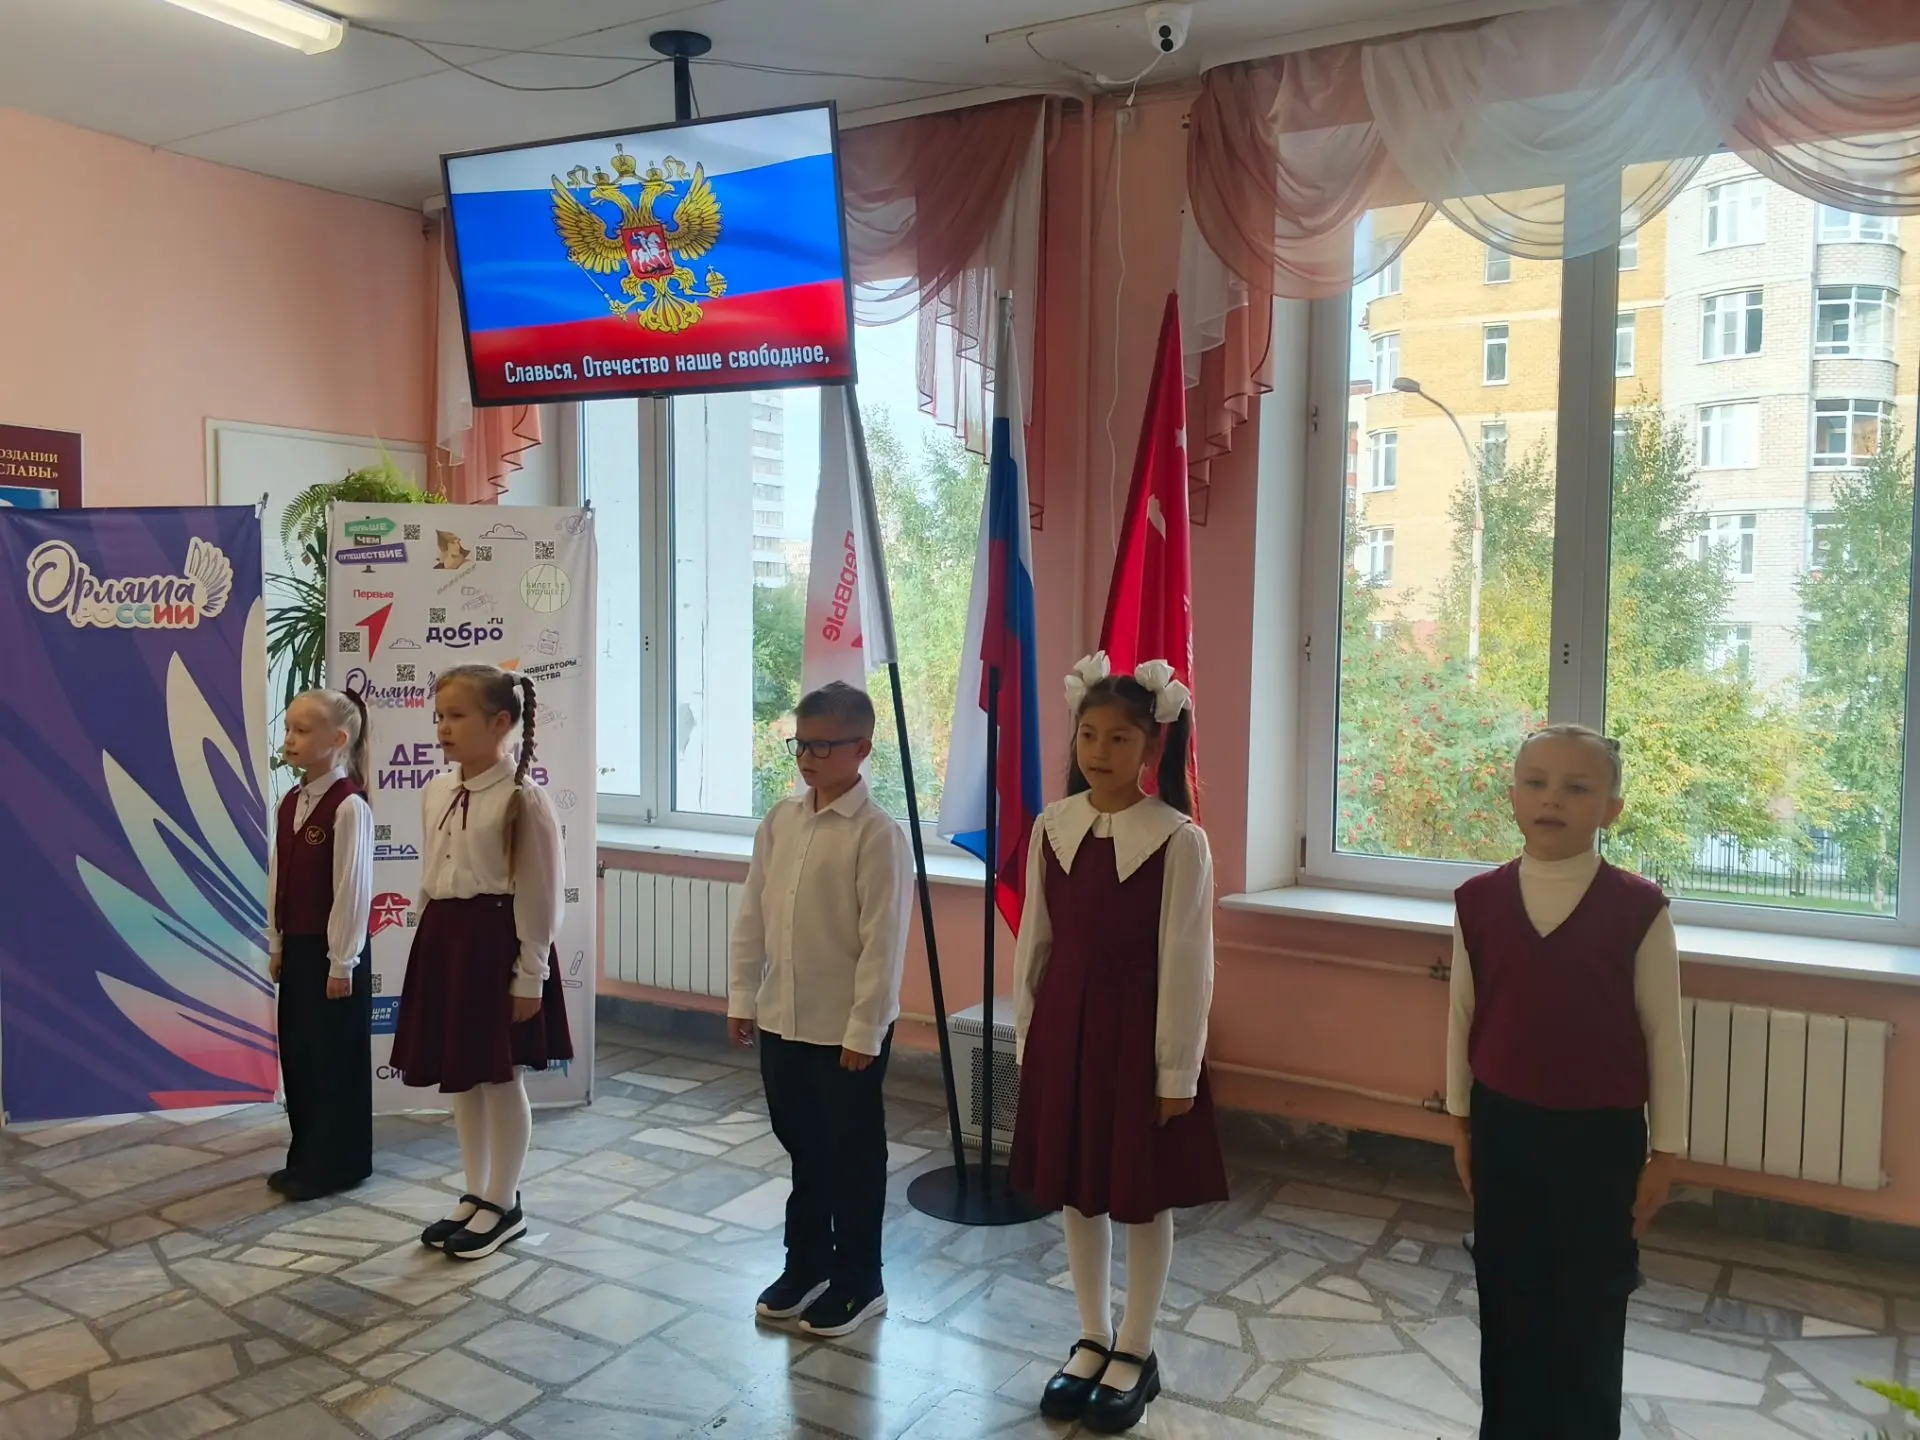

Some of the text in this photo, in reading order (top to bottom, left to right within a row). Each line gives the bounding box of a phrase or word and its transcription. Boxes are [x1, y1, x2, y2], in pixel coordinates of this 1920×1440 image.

[505, 342, 830, 384] Славься, Отечество наше свободное,
[0, 448, 58, 463] ОЗДАНИИ
[338, 549, 403, 561] ПУТЕШЕСТВИЕ
[33, 544, 195, 615] Орлята
[353, 589, 393, 599] Первые
[426, 622, 503, 645] добро
